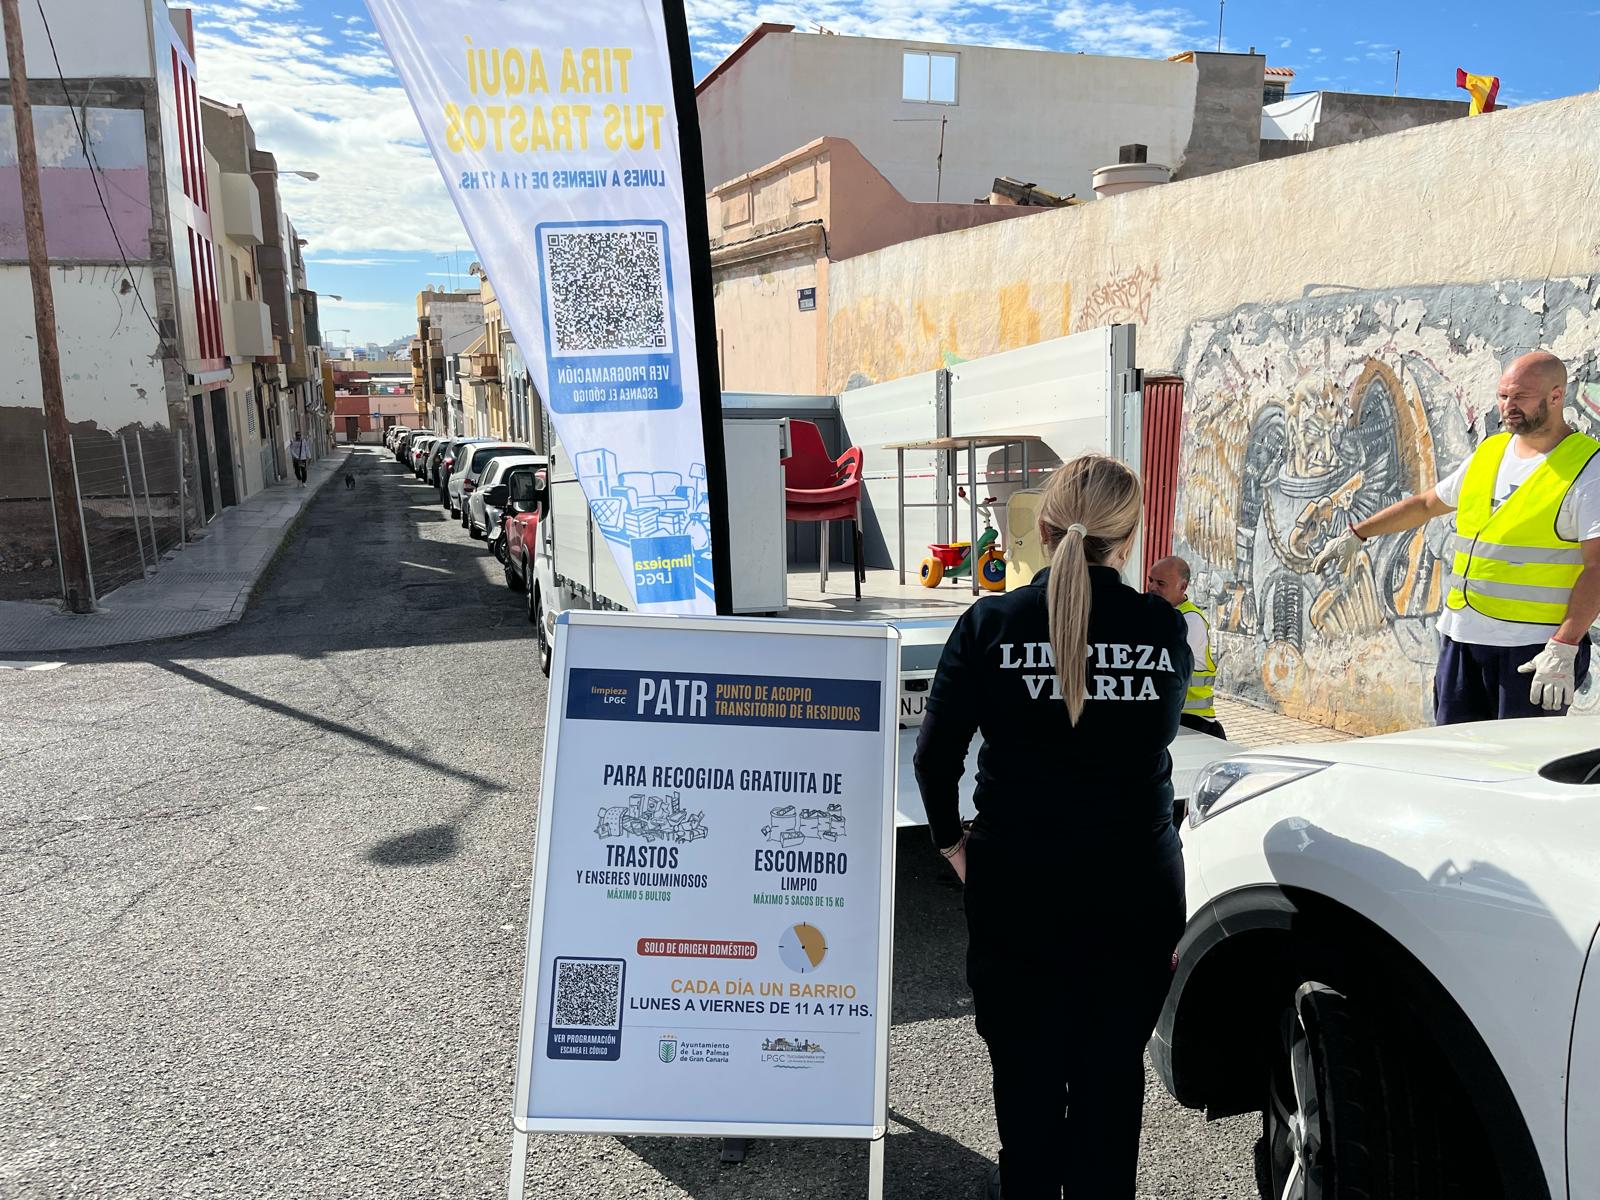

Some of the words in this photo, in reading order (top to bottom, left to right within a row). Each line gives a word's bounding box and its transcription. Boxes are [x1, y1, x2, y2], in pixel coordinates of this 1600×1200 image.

[591, 686, 628, 696] limpieza
[716, 684, 752, 700] PUNTO
[754, 686, 769, 700] DE
[771, 687, 812, 702] ACOPIO
[1022, 675, 1160, 700] VIRIA
[604, 696, 626, 704] LPGC
[637, 677, 708, 717] PATR
[901, 696, 928, 715] NJ
[715, 700, 787, 718] TRANSITORIO
[789, 704, 803, 719] DE
[806, 705, 860, 721] RESIDUOS
[603, 764, 647, 787] PARA
[652, 766, 735, 790] RECOGIDA
[739, 769, 818, 794] GRATUITA
[822, 773, 843, 795] DE
[606, 844, 679, 869] TRASTOS
[755, 849, 847, 875] ESCOMBRO
[576, 870, 583, 884] Y
[585, 870, 630, 886] ENSERES
[633, 872, 708, 888] VOLUMINOSOS
[781, 877, 817, 891] LIMPIO
[607, 887, 637, 900] MÁXIMO
[638, 889, 644, 900] 5
[645, 890, 671, 901] BULTOS
[753, 892, 783, 905] MÁXIMO
[784, 895, 790, 905] 5
[791, 895, 814, 906] SACOS
[815, 896, 824, 906] DE
[825, 896, 833, 907] 15
[834, 897, 845, 908] KG
[644, 942, 664, 953] SOLO
[666, 943, 677, 954] DE
[678, 943, 708, 955] ORIGEN
[710, 942, 755, 956] DOMÉSTICO
[671, 979, 720, 994] CADA
[725, 978, 754, 995] DÍA
[760, 982, 783, 996] UN
[789, 983, 856, 999] BARRIO
[630, 997, 681, 1011] LUNES
[684, 999, 696, 1012] A
[700, 999, 765, 1013] VIERNES
[769, 1001, 790, 1014] DE
[795, 1002, 809, 1015] 11
[813, 1003, 825, 1015] A
[829, 1004, 844, 1016] 17
[849, 1004, 873, 1017] HS.
[554, 1034, 566, 1043] VER
[567, 1034, 616, 1044] PROGRAMACIÓN
[680, 1041, 730, 1049] Ayuntamiento
[560, 1046, 581, 1054] ESCANEA
[583, 1047, 588, 1055] EL
[589, 1046, 608, 1055] CÓDIGO
[761, 1054, 785, 1062] LPGC
